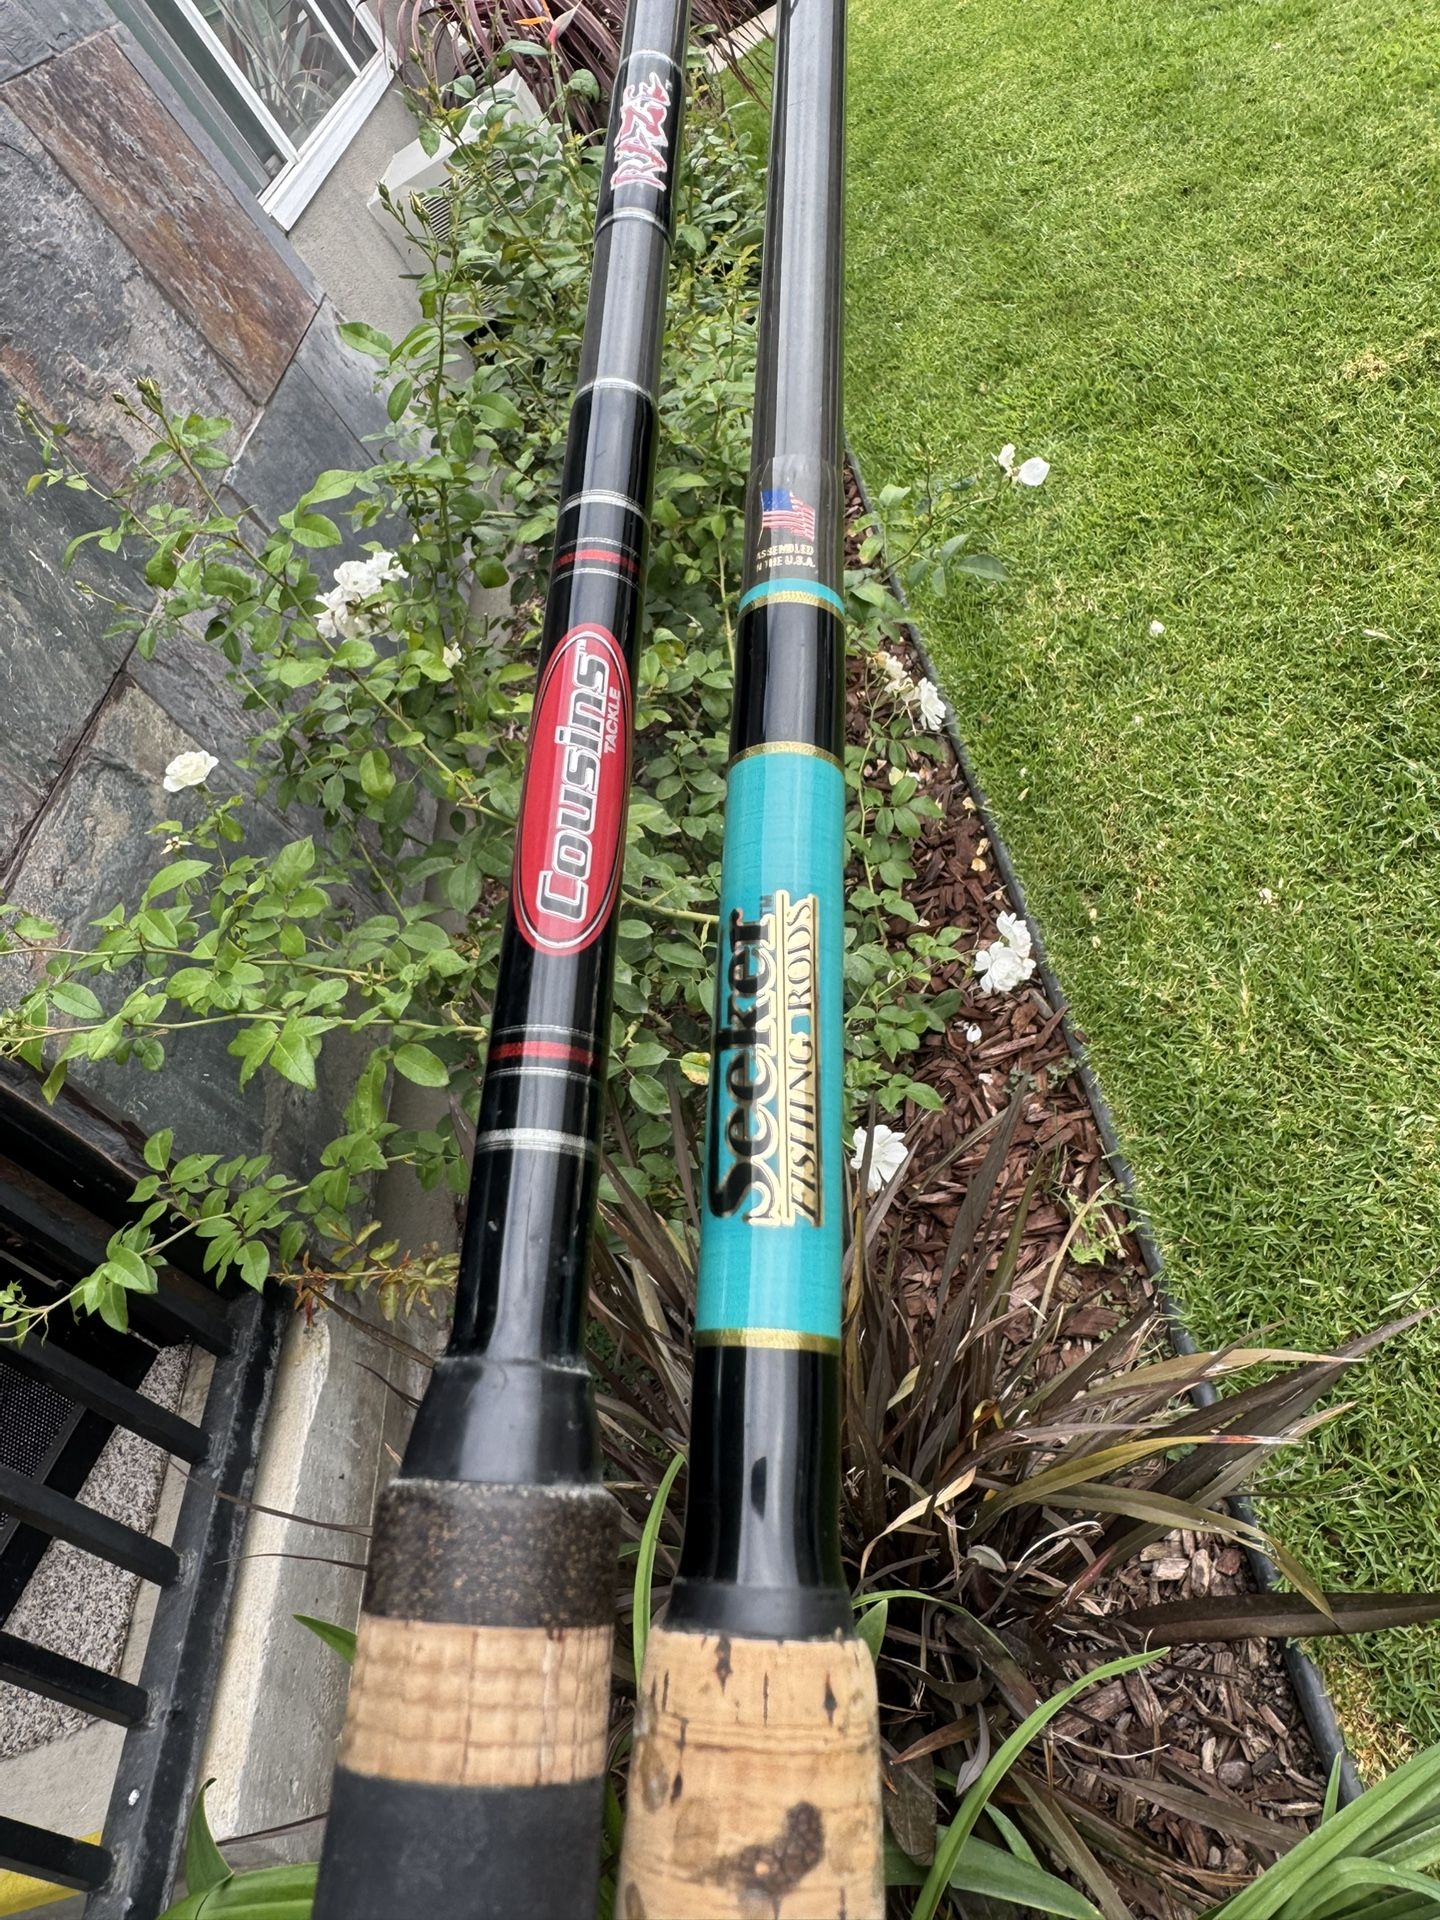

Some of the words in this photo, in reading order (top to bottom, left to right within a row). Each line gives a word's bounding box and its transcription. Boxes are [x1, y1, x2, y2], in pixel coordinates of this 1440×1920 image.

[757, 543, 814, 559] ASSEMBLED
[536, 652, 610, 922] Cousins
[604, 687, 621, 754] TACKLE
[787, 900, 812, 1011] RODS
[708, 907, 777, 1226] Seeker
[786, 1036, 819, 1223] FISHING
